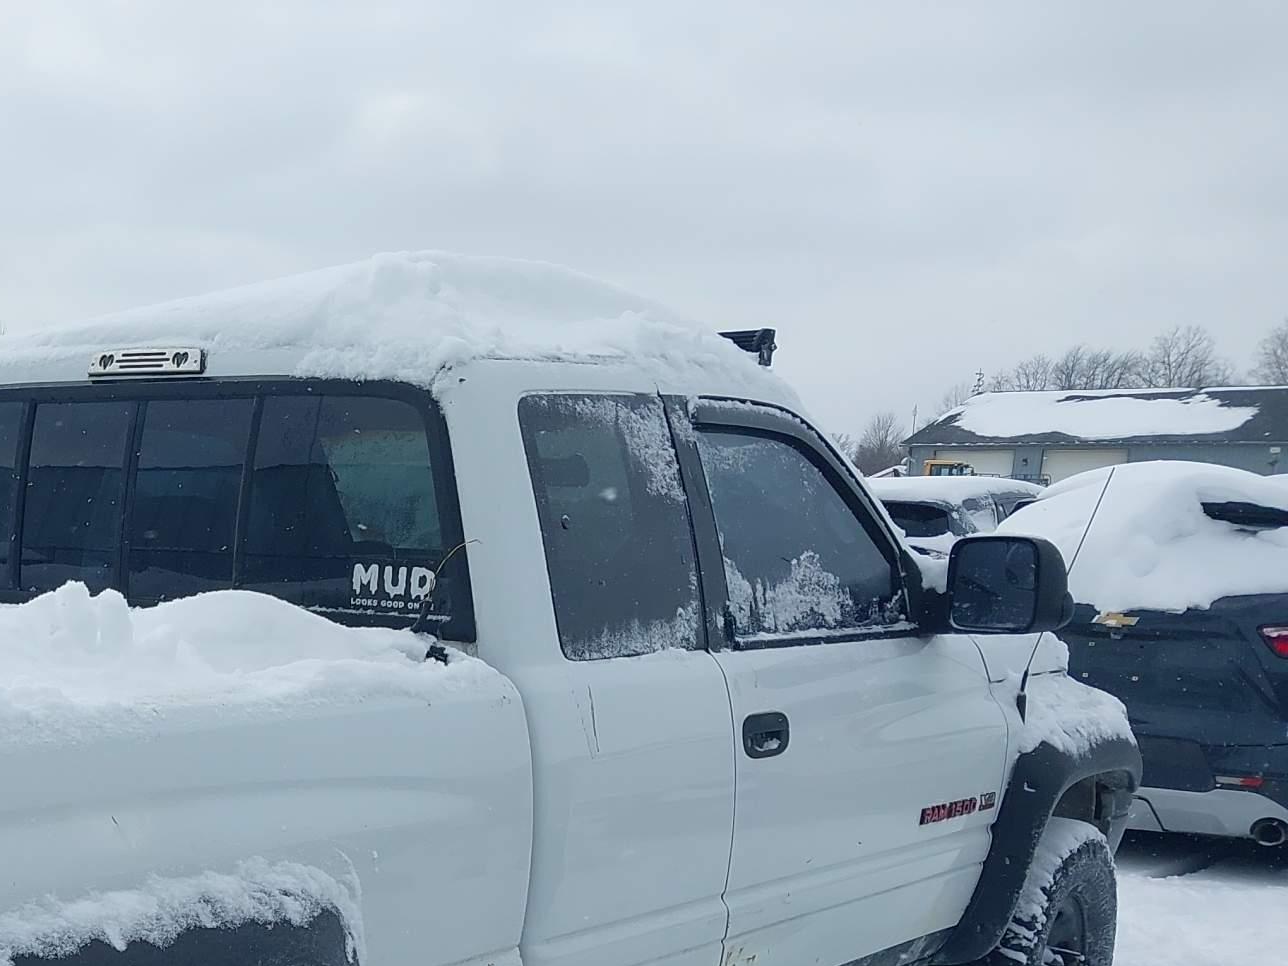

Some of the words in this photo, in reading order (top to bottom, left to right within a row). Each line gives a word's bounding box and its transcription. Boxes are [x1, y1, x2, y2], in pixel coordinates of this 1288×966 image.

[352, 563, 436, 600] MUD
[350, 597, 378, 607] LOOKS
[380, 600, 405, 609] GOOD
[407, 602, 420, 610] ON
[922, 804, 949, 824] RAM
[950, 799, 977, 818] 1500
